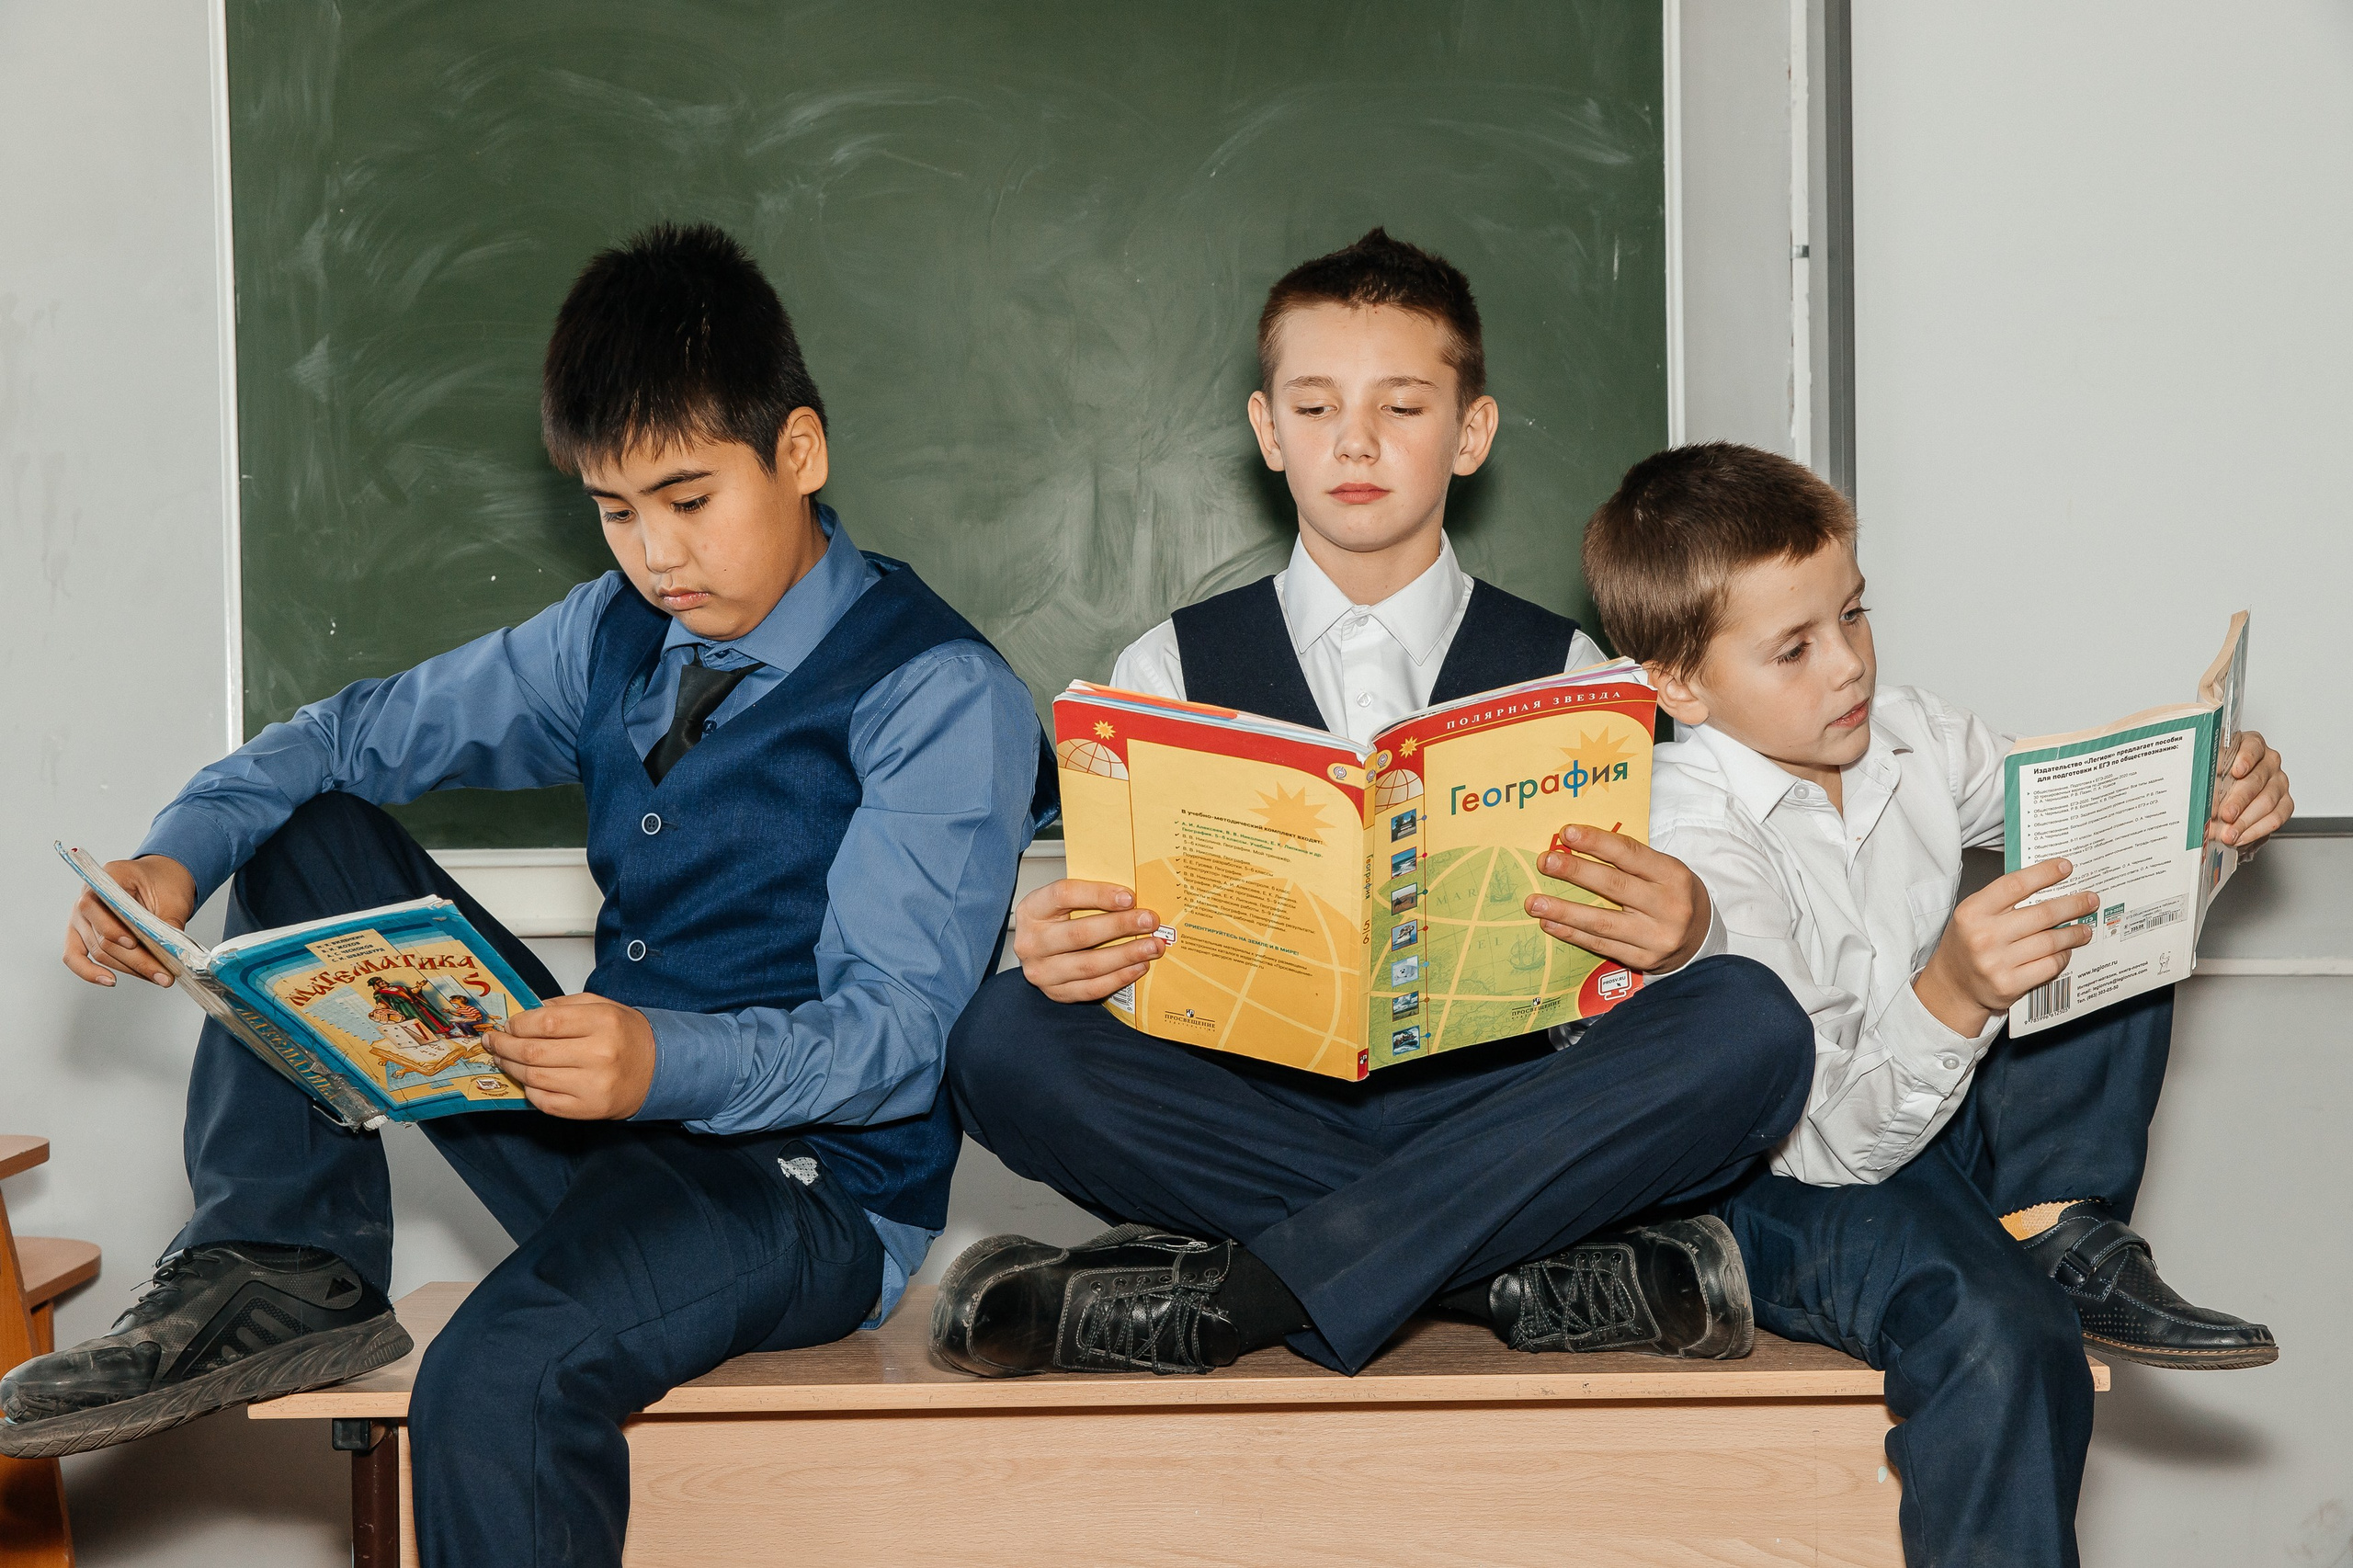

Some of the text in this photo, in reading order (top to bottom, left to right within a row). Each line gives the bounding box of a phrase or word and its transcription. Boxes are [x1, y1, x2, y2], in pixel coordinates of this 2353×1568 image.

[1446, 691, 1620, 729] ПОЛЯРНАЯ ЗВЕЗДА
[2034, 736, 2182, 774] Издательство «Легион» предлагает пособия
[2053, 767, 2092, 779] подготовки
[2120, 745, 2178, 762] обществознанию:
[1451, 760, 1628, 816] География
[1188, 811, 1263, 830] учебно-методический
[1264, 828, 1296, 838] комплект
[1364, 854, 1374, 899] География
[1184, 923, 1238, 939] ОРИЕНТИРУЙТЕСЬ
[1248, 939, 1268, 948] ЗЕМЛЕ
[341, 944, 374, 954] ЧЕСНОКОВ
[1603, 976, 1626, 986] PROSV.RU
[2078, 960, 2118, 979] www.legionr.ru
[462, 972, 491, 997] 5
[1512, 1000, 1561, 1016] ПРОСВЕЩЕНИЕ
[1165, 1014, 1215, 1028] ПРОСВЕЩЕНИЕ
